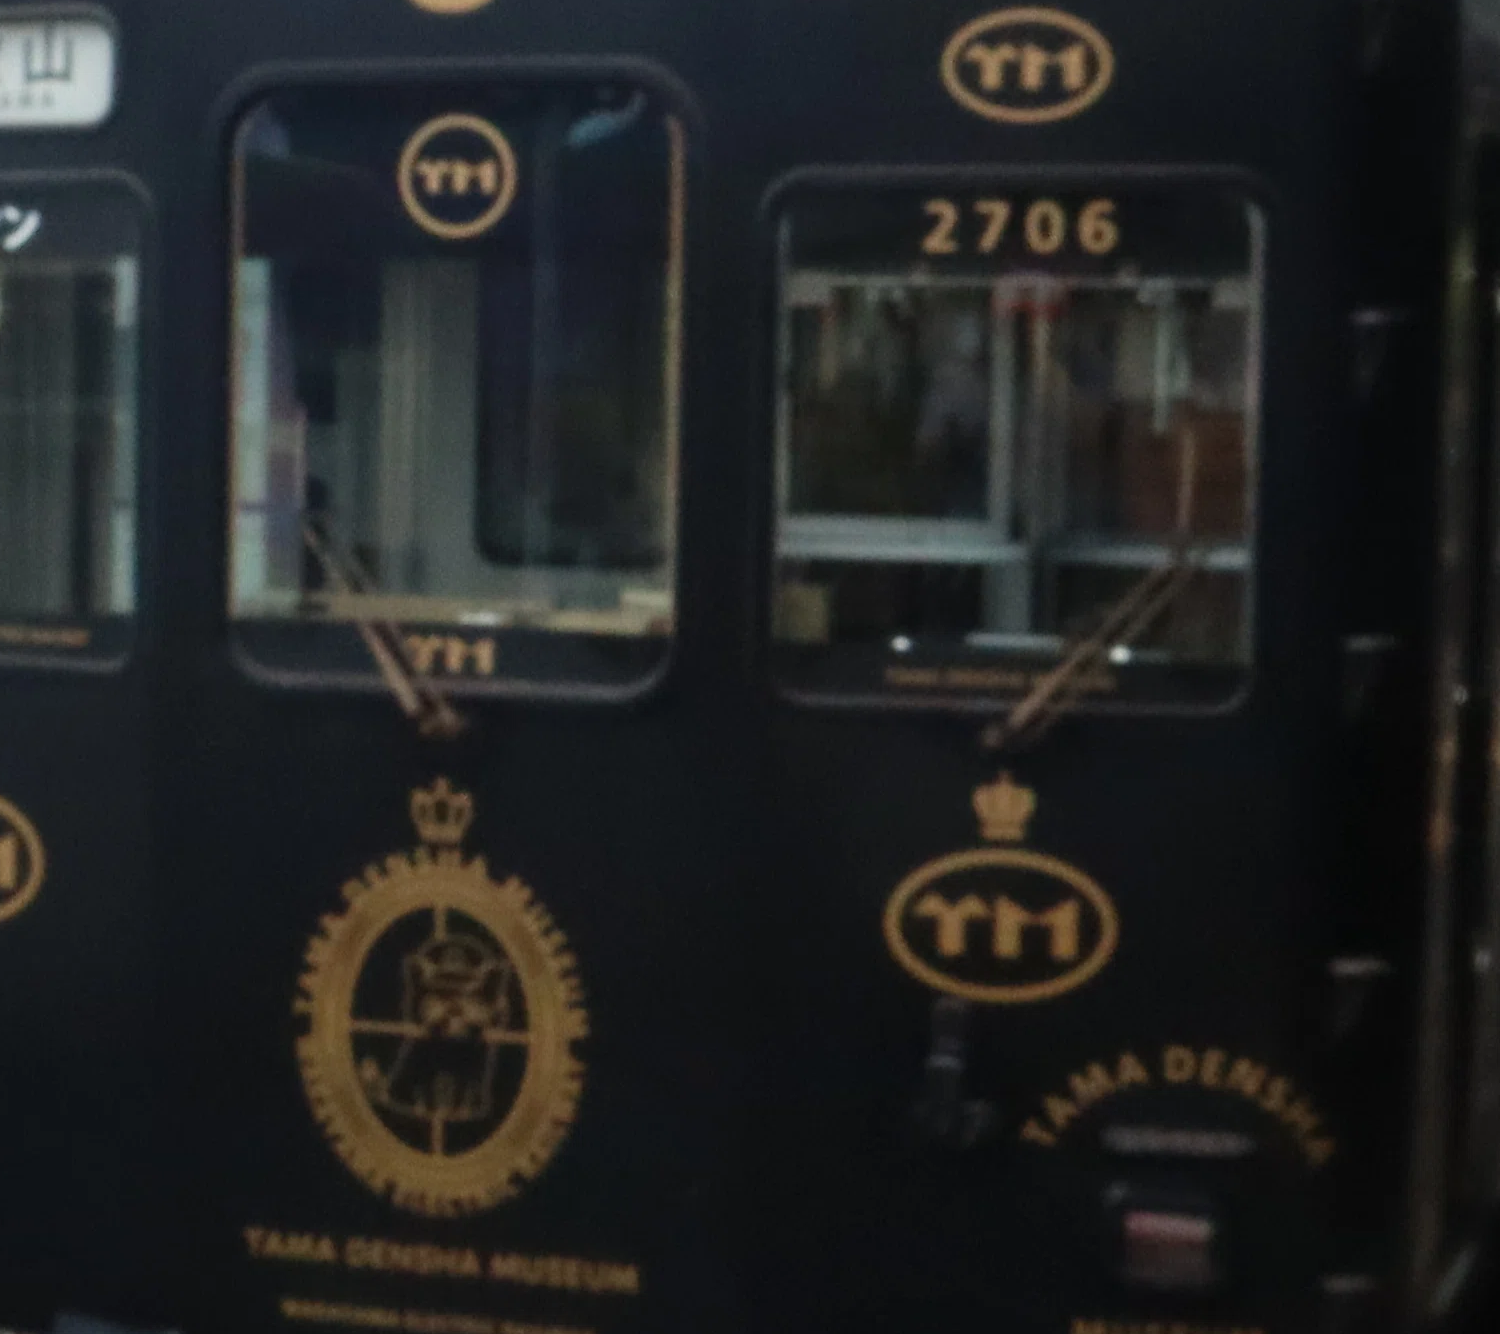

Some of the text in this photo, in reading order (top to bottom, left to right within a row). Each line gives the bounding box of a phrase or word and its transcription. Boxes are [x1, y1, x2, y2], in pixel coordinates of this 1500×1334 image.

[920, 198, 1120, 256] 2706
[1019, 1043, 1337, 1165] TAMA DENSHA
[243, 1225, 641, 1296] TAMA DENSHA MUSEUM
